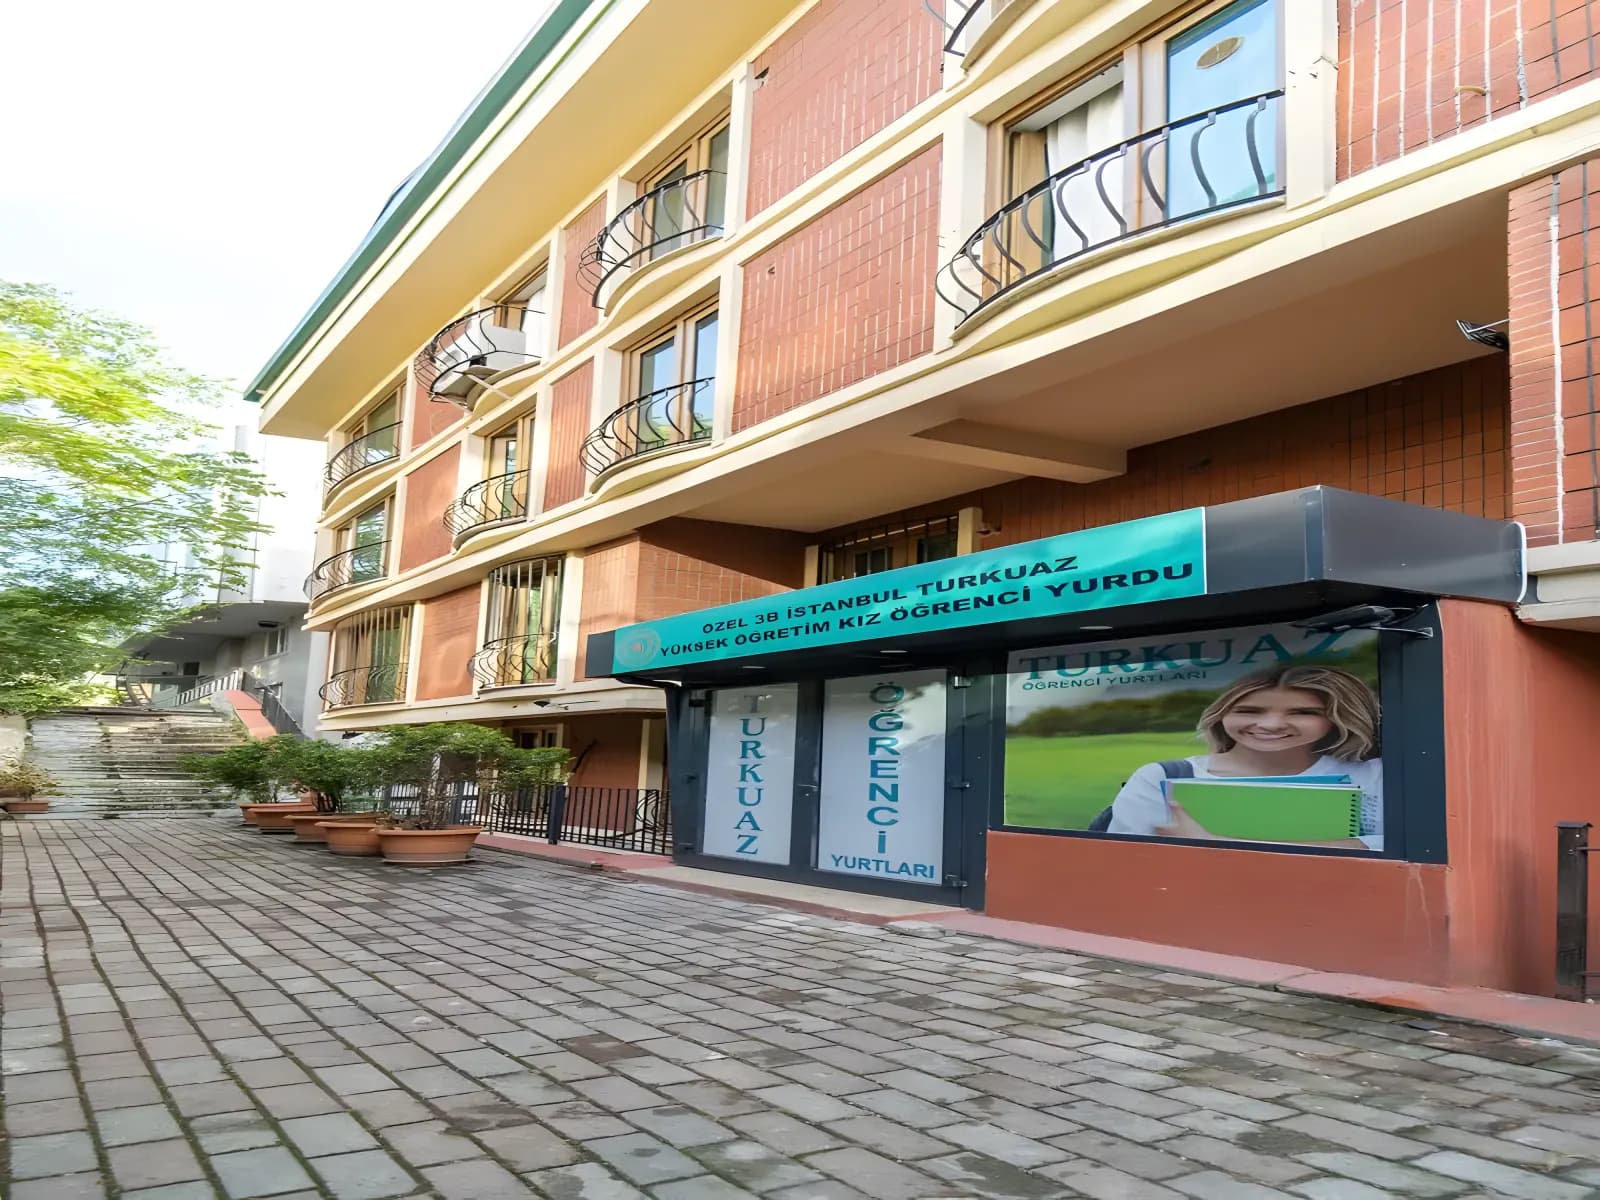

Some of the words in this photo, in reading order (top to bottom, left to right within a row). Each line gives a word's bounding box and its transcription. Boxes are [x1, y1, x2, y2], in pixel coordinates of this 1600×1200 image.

[754, 611, 779, 625] 3B
[787, 588, 908, 619] İSTANBUL
[916, 556, 1078, 596] TURKUAZ
[839, 612, 881, 630] KIZ
[890, 585, 1031, 622] ÖĞRENCİ
[1044, 563, 1193, 598] YURDU
[1019, 629, 1351, 681] TURKUAZ
[733, 694, 768, 855] TURKUAZ
[866, 681, 904, 854] ÖĞRENCİ
[831, 853, 935, 879] YURTLARI
